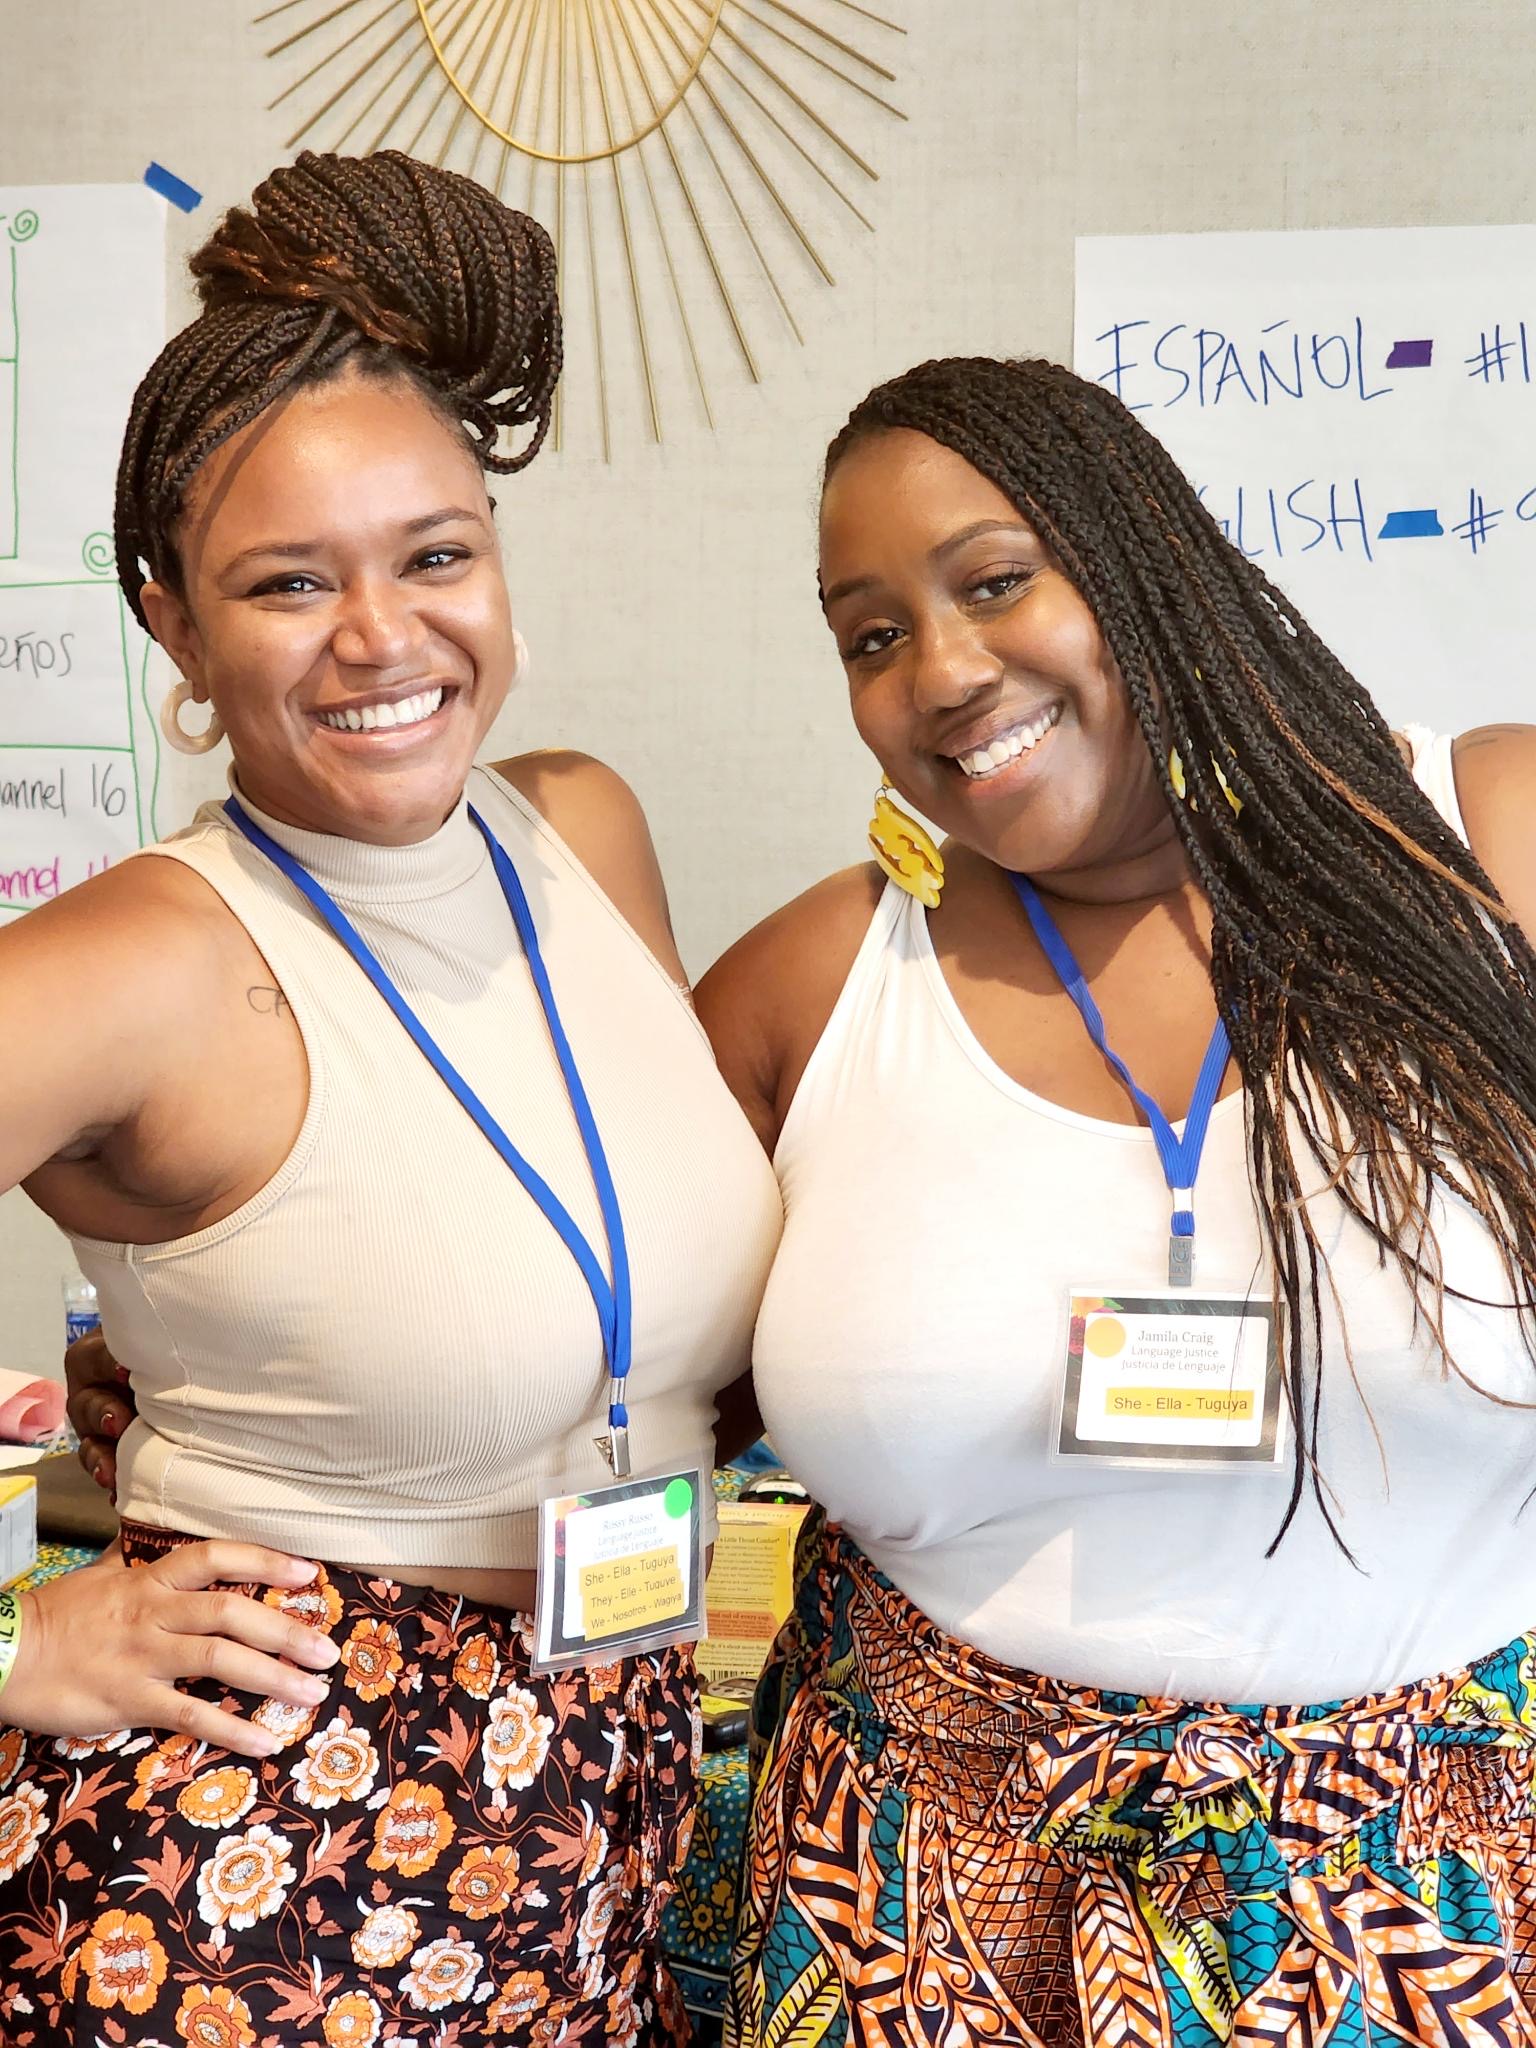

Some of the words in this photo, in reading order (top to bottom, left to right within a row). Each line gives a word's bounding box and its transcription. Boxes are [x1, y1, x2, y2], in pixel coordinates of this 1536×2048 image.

[1096, 316, 1394, 411] ESPAÑOL
[1197, 478, 1374, 563] LISH
[91, 762, 126, 817] 16
[1138, 1330, 1178, 1343] Jamila
[1182, 1331, 1214, 1345] Craig
[1131, 1345, 1182, 1358] Language
[1184, 1348, 1219, 1358] Justice
[1121, 1359, 1159, 1370] Justicia
[1162, 1361, 1175, 1370] de
[1178, 1361, 1226, 1374] Lenguaje
[1114, 1397, 1142, 1410] She
[1156, 1397, 1182, 1410] Ella
[1195, 1397, 1247, 1413] Tuguya
[585, 1570, 604, 1587] She
[613, 1565, 631, 1579] Ella
[640, 1554, 674, 1571] Tuguya
[591, 1594, 613, 1609] They
[621, 1586, 637, 1600] Elle
[591, 1618, 605, 1630] We
[612, 1604, 647, 1623] Nosotros
